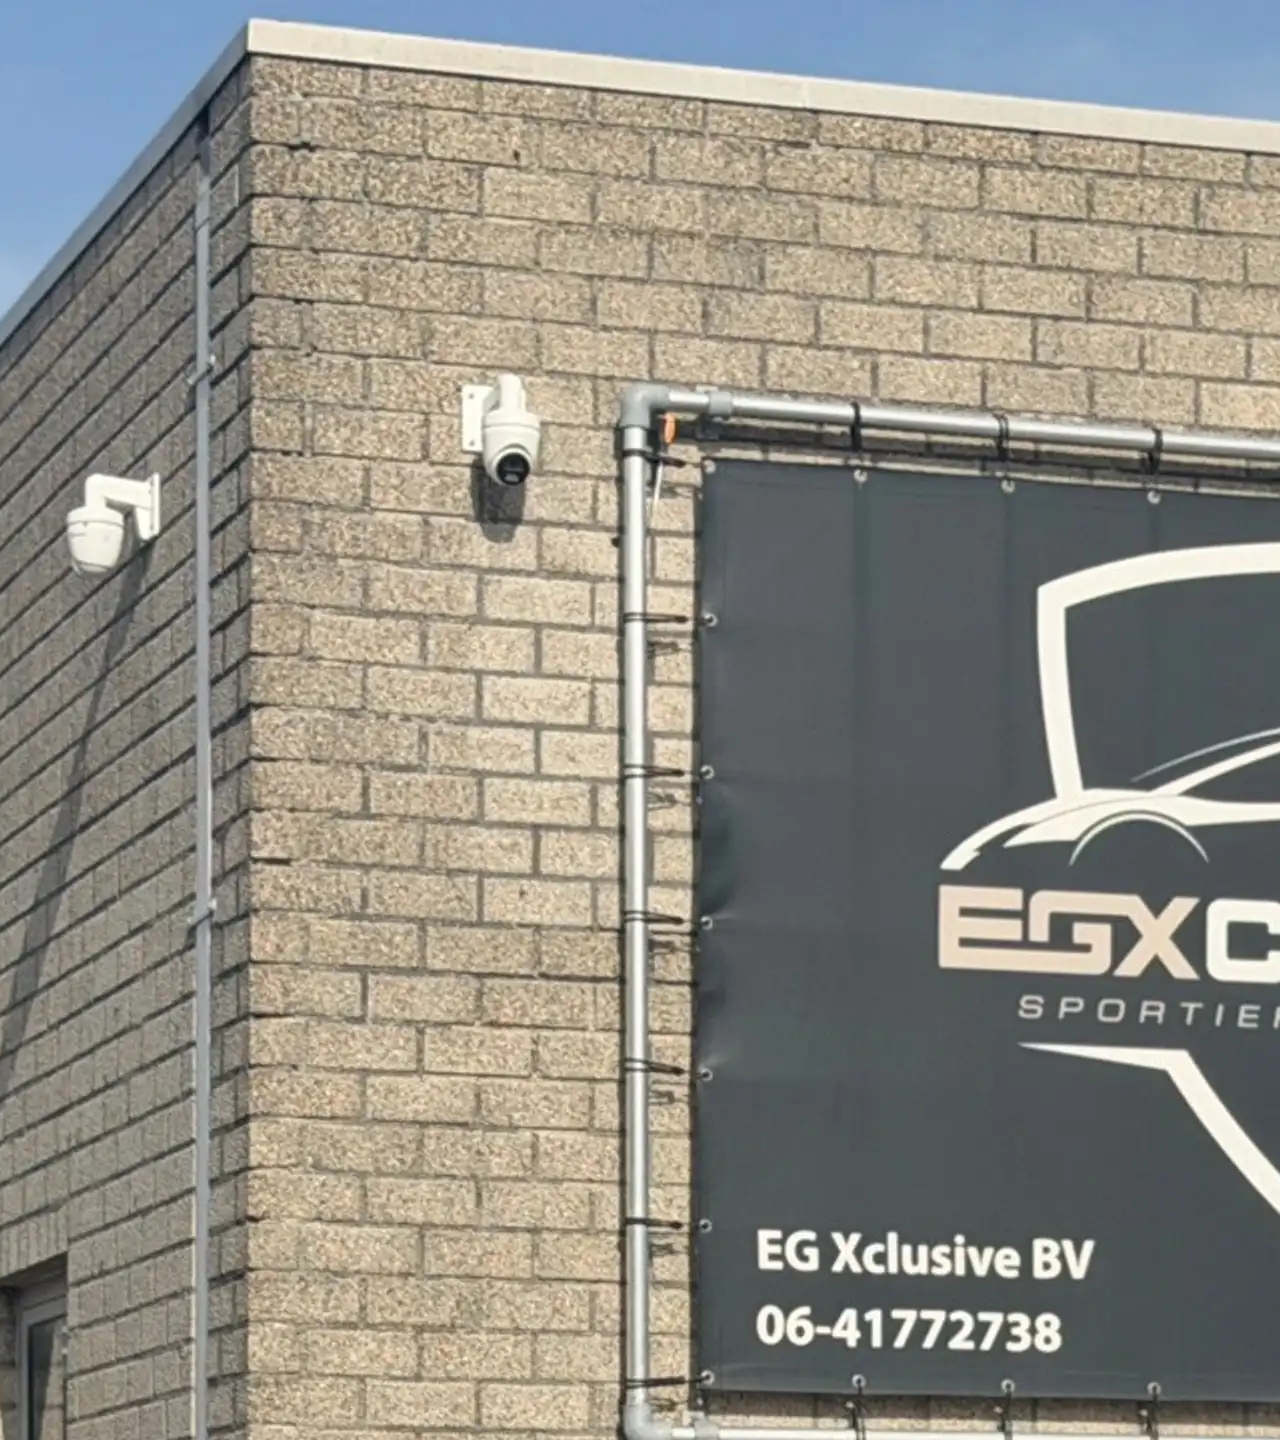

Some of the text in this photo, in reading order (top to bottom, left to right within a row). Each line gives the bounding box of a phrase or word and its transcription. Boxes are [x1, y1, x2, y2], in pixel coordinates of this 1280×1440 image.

[757, 1229, 1095, 1279] EG Xclusive BV
[756, 1305, 1062, 1353] 06-41772738
